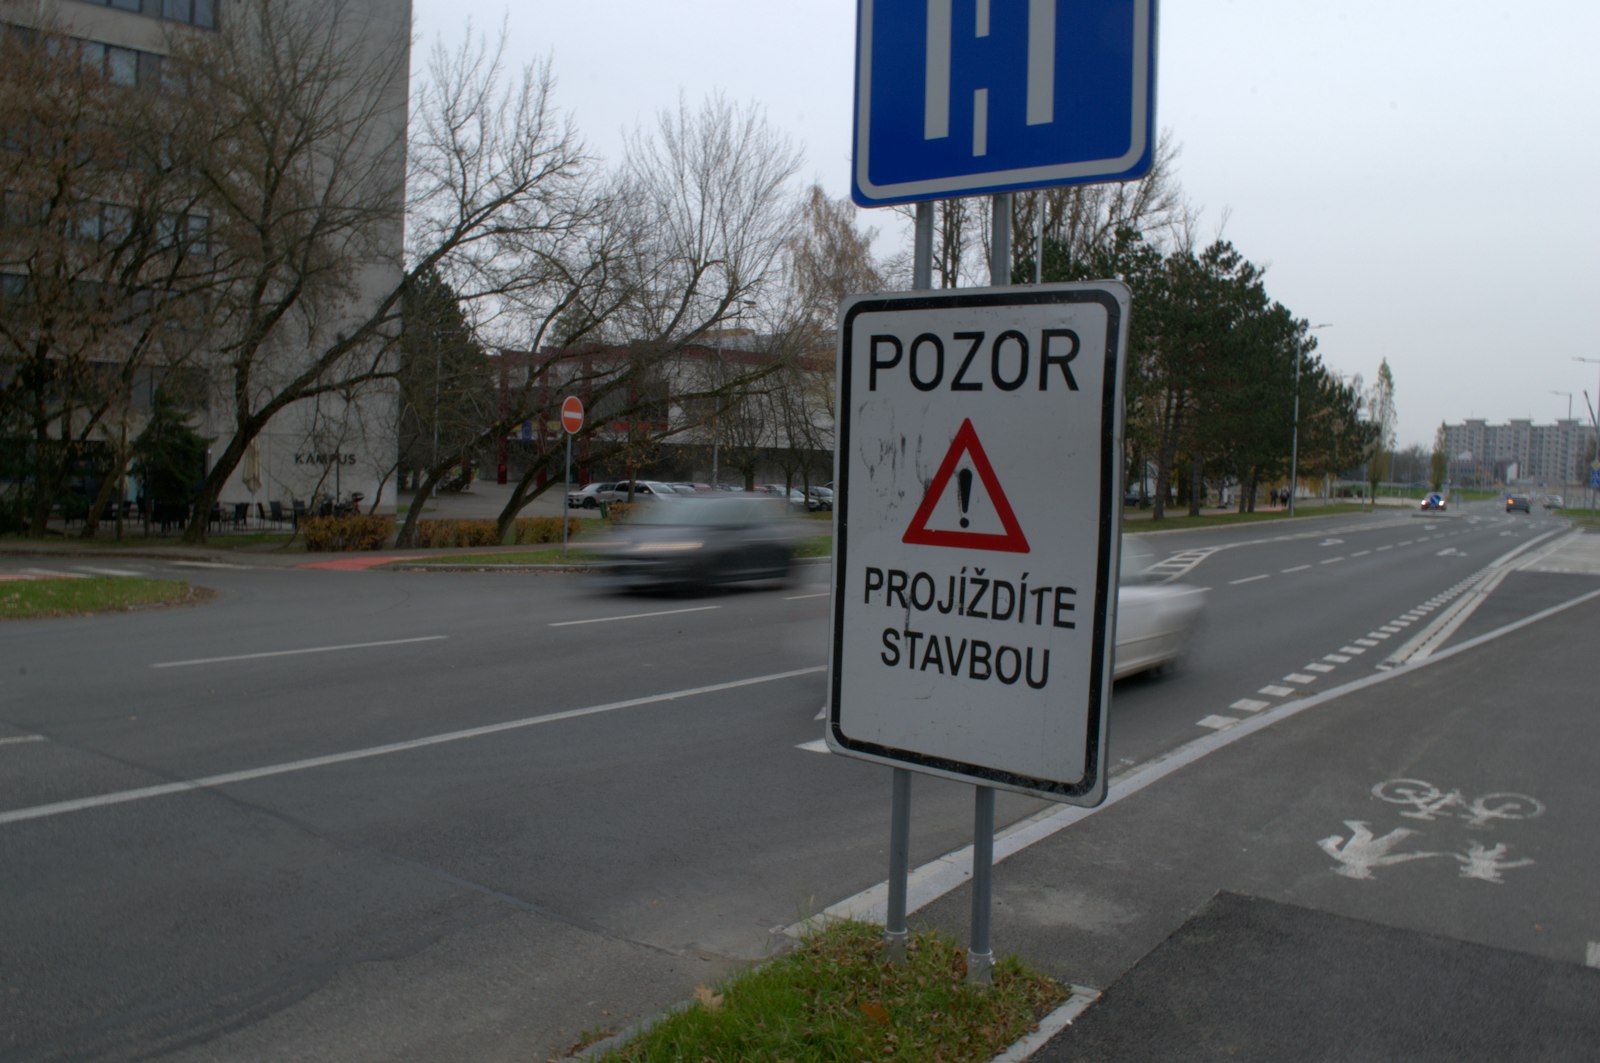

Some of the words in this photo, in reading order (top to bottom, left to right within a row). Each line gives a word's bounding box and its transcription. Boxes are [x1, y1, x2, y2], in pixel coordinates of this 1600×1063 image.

[869, 329, 1080, 391] POZOR
[294, 453, 356, 465] KAMPUS
[864, 566, 1077, 629] PROJÍŽDÍTE
[881, 627, 1050, 690] STAVBOU
